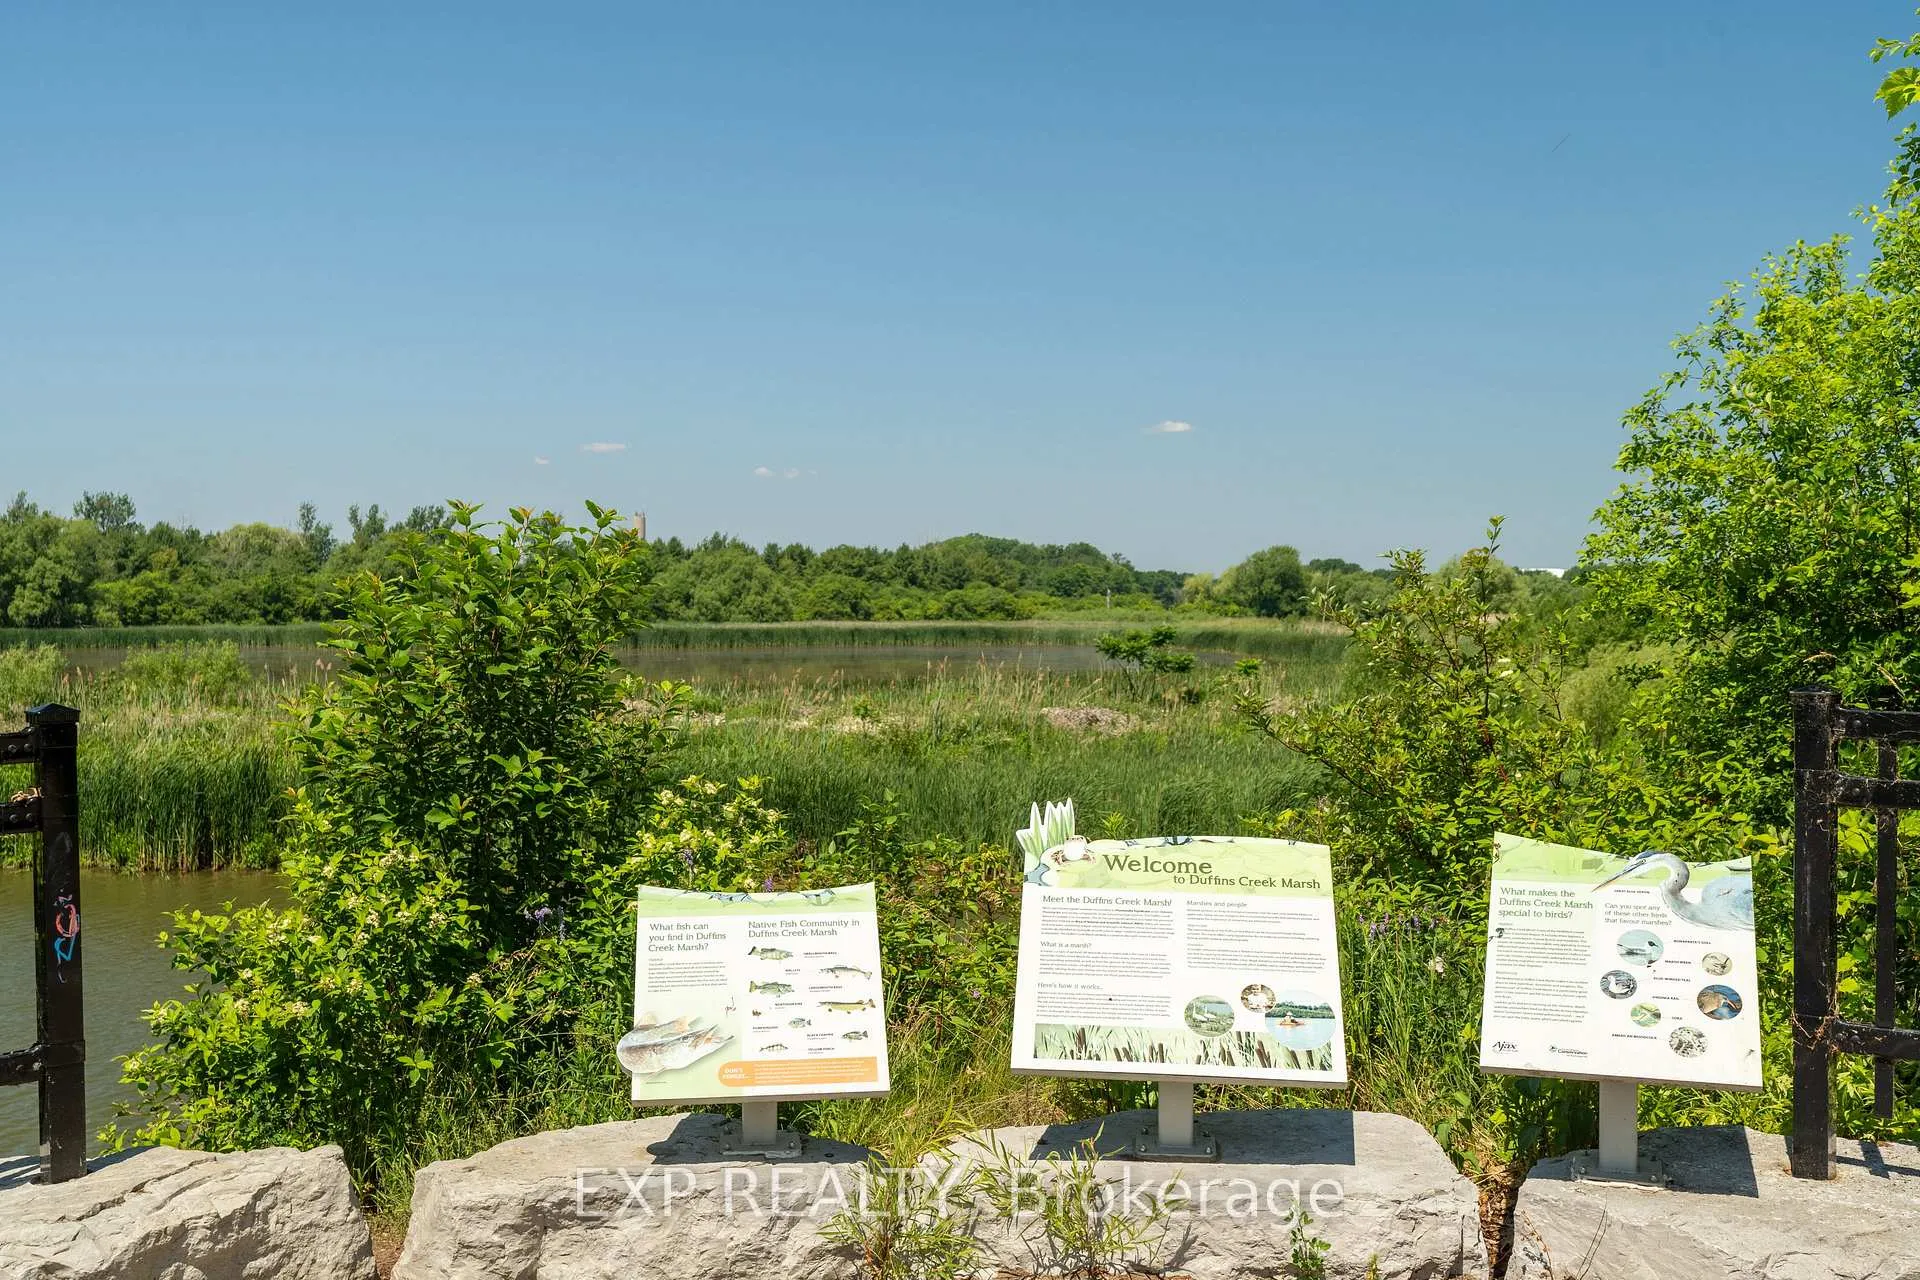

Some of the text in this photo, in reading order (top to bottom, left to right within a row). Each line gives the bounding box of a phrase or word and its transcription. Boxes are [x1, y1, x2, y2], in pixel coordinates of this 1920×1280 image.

[1102, 854, 1212, 874] Welcome
[1173, 874, 1321, 889] to Duffins Creek Marsh
[1500, 887, 1575, 897] What makes the
[1042, 895, 1064, 903] Meet
[1067, 895, 1080, 903] the
[1083, 896, 1113, 905] Duffins
[1115, 897, 1141, 906] Creek
[1499, 897, 1593, 909] Duffins Creek Marsh
[1498, 909, 1573, 919] special to birds?
[649, 923, 674, 931] What
[676, 922, 691, 930] fish
[748, 920, 777, 929] Native
[780, 920, 797, 928] Fish
[800, 919, 849, 928] Community
[649, 932, 727, 943] you find in Duffins
[748, 928, 838, 938] Duffins Creek Marsh
[648, 943, 709, 952] Creek Marsh?
